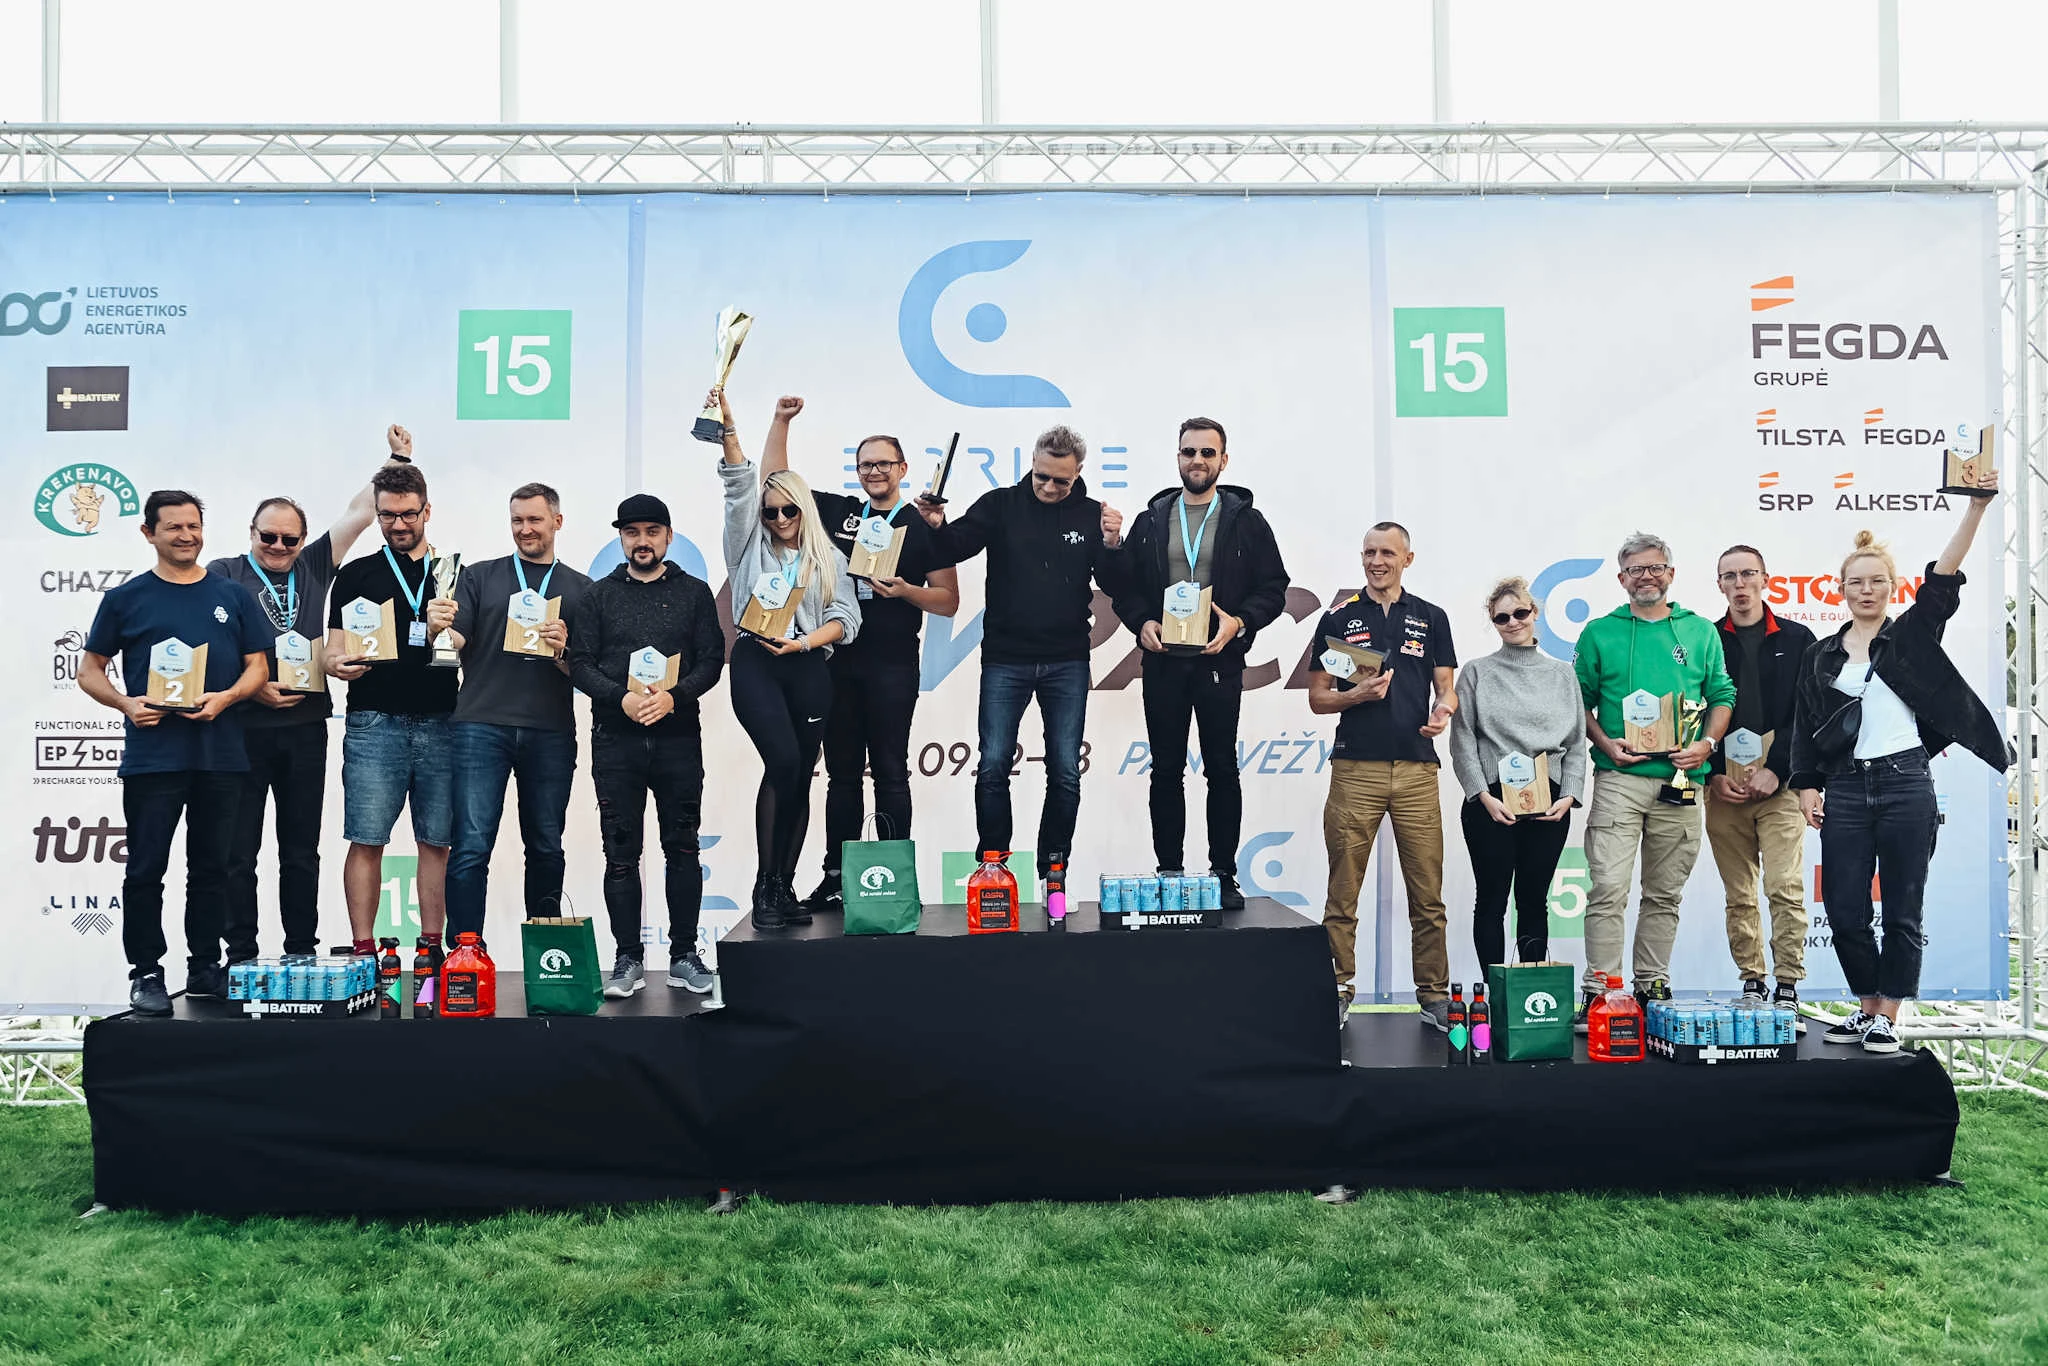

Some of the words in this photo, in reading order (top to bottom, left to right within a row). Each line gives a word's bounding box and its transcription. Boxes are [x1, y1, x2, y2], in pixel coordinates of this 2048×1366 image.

[87, 286, 159, 298] LIETUVOS
[86, 304, 187, 317] ENERGETIKOS
[84, 320, 167, 335] AGENTŪRA
[1752, 322, 1949, 361] FEGDA
[473, 335, 552, 396] 15
[1409, 332, 1489, 393] 15
[1754, 367, 1829, 386] GRUPĖ
[77, 393, 121, 402] BATTERY
[1757, 428, 1846, 446] TILSTA
[1864, 428, 1945, 446] FEGDA
[38, 467, 137, 513] KREKENAVOS
[1758, 493, 1814, 512] SRP
[1835, 493, 1951, 512] ALKESTA
[362, 637, 379, 657] 2
[164, 680, 184, 703] 2
[35, 721, 104, 730] FUNCTIONAL
[45, 746, 67, 761] EP
[41, 777, 86, 785] RECHARGE
[1149, 914, 1203, 925] BATTERY
[269, 1003, 323, 1014] BATTERY
[1726, 1048, 1780, 1060] BATTERY
